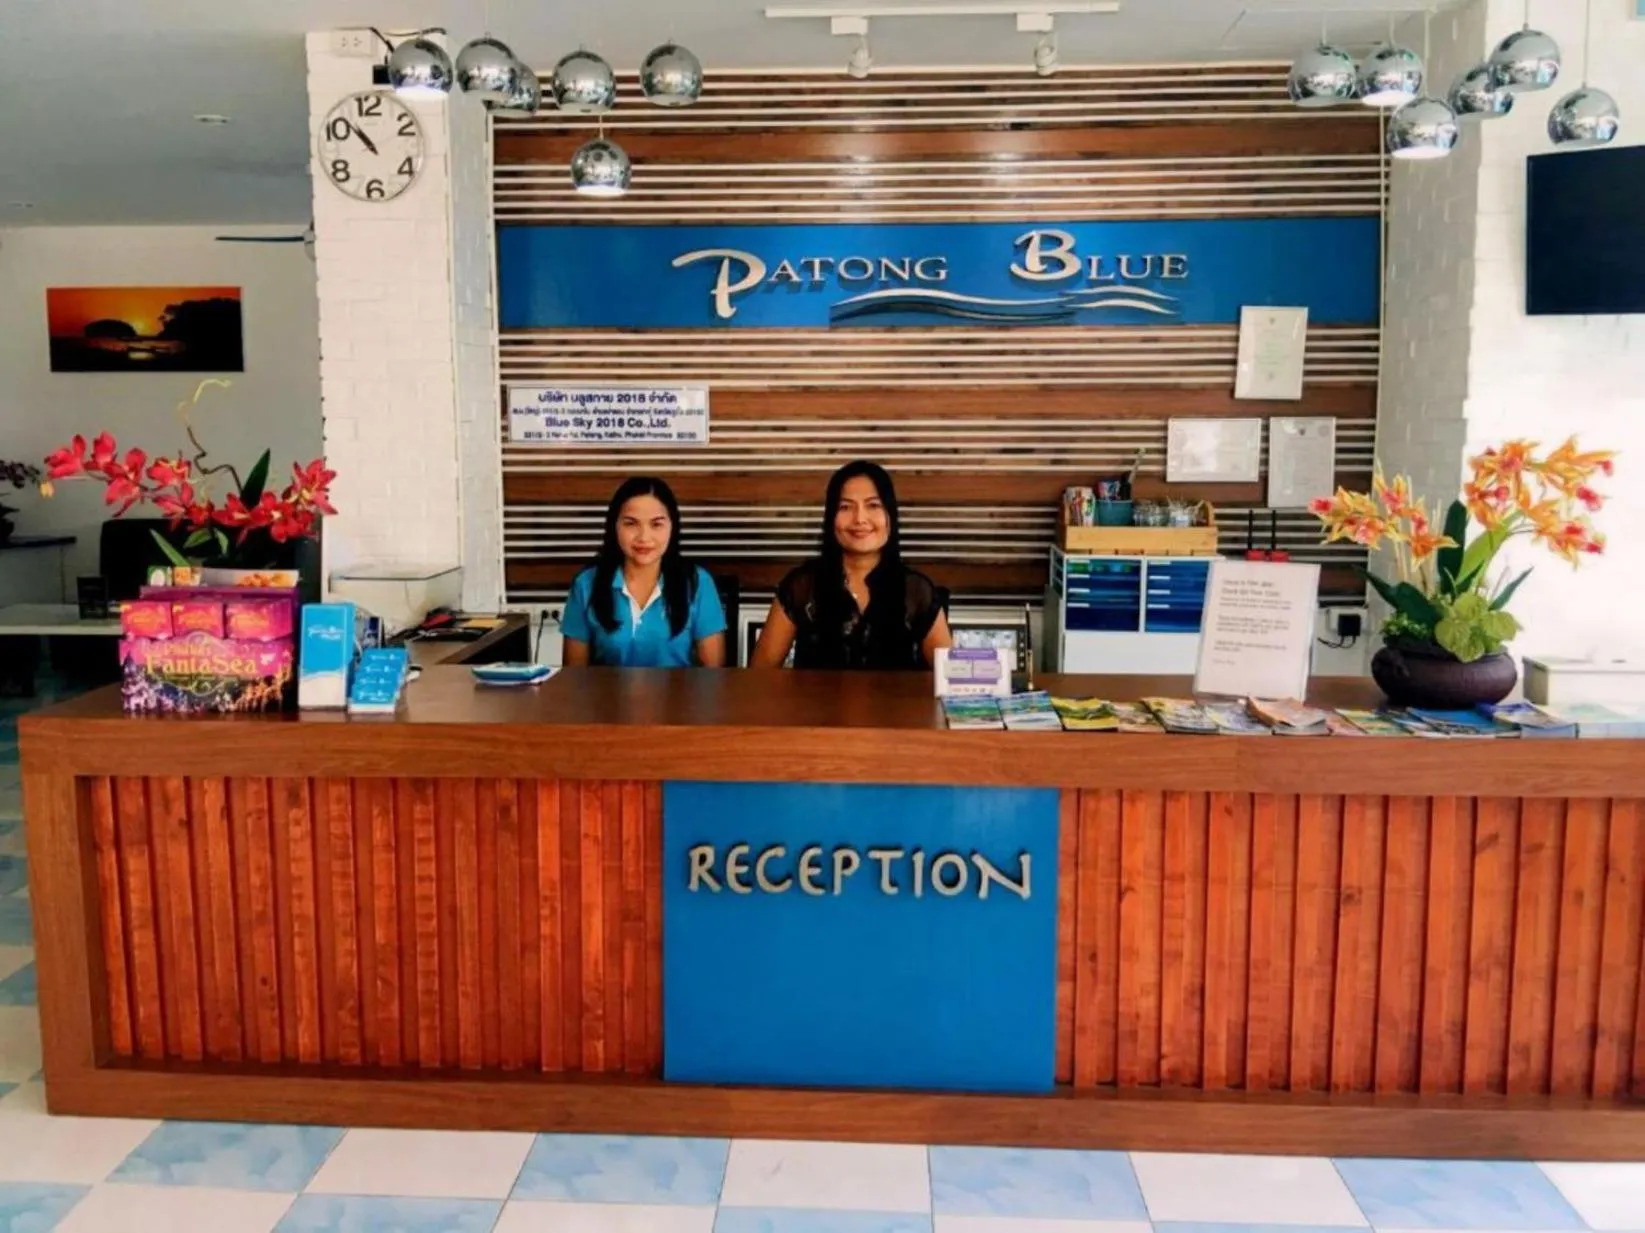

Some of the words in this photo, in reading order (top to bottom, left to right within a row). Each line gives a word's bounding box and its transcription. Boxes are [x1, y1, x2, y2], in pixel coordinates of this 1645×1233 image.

[355, 95, 382, 117] 12
[325, 117, 351, 141] 10
[397, 112, 416, 136] 2
[331, 159, 351, 182] 8
[397, 156, 415, 177] 4
[366, 179, 385, 199] 6
[672, 248, 948, 319] PATONG
[1010, 229, 1189, 282] BLUE
[545, 416, 570, 427] Blue
[572, 416, 592, 429] Sky
[596, 417, 625, 428] 2018
[688, 845, 1032, 900] RECEPTION
